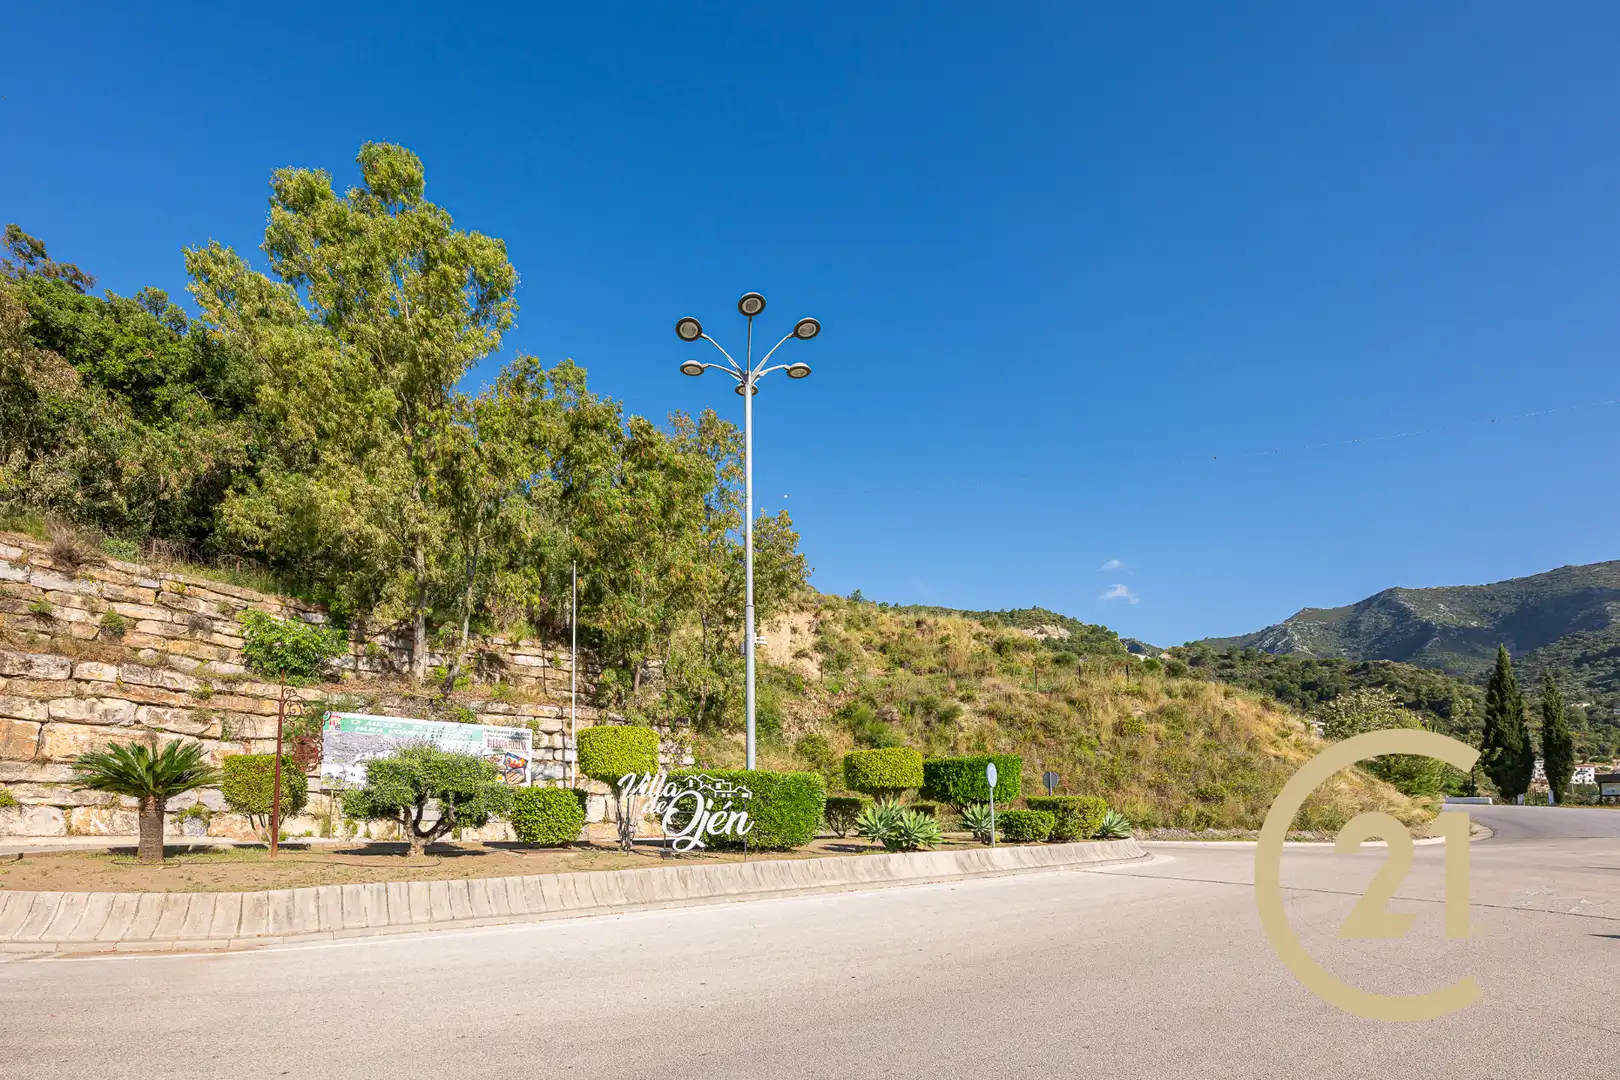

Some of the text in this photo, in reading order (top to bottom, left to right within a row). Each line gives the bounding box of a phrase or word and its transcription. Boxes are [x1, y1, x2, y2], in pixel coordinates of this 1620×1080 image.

[617, 771, 682, 800] Villa
[641, 798, 669, 815] de
[662, 790, 755, 852] Ojén
